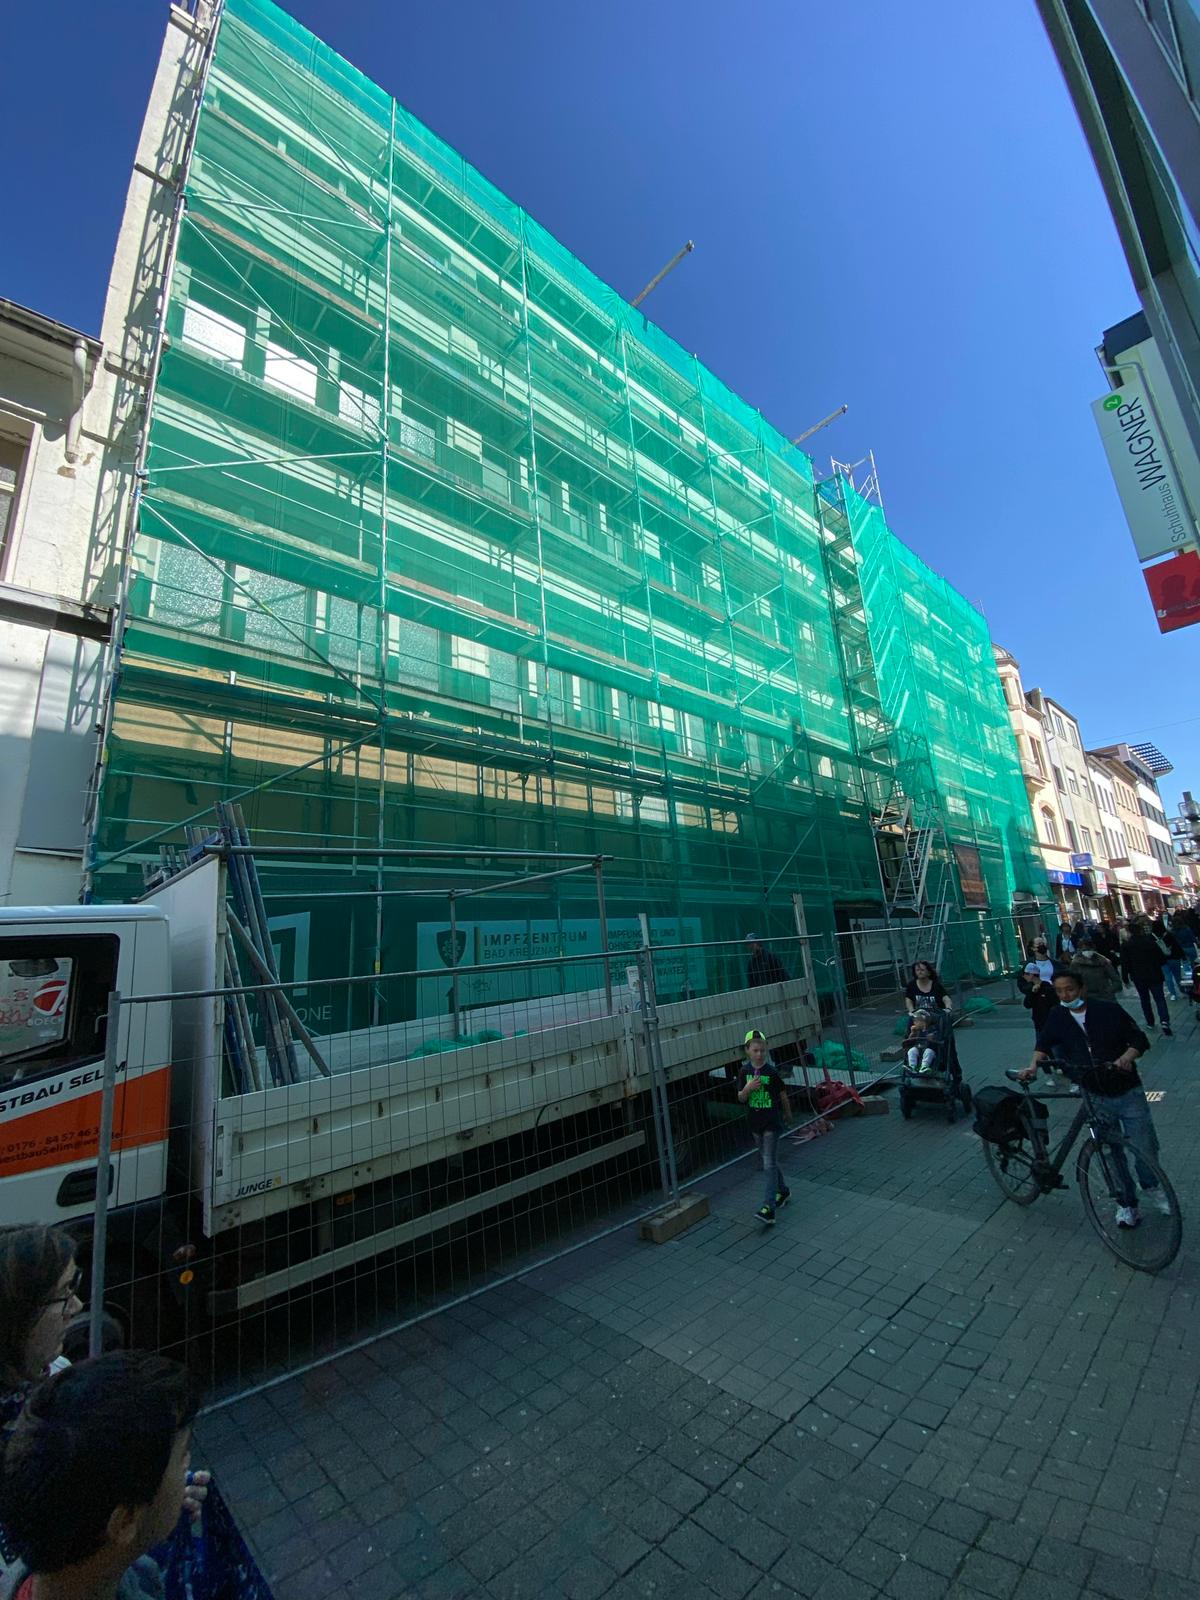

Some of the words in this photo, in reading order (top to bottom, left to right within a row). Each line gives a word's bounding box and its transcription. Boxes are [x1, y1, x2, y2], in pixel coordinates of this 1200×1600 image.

[1117, 397, 1167, 491] WAGNER
[1158, 483, 1187, 543] Schuhhaus
[484, 930, 588, 946] IMPFZENTRUM
[484, 948, 506, 960] BAD
[69, 1060, 127, 1089] SELM
[7, 1140, 36, 1153] 0176
[235, 1178, 273, 1198] JUNGE
